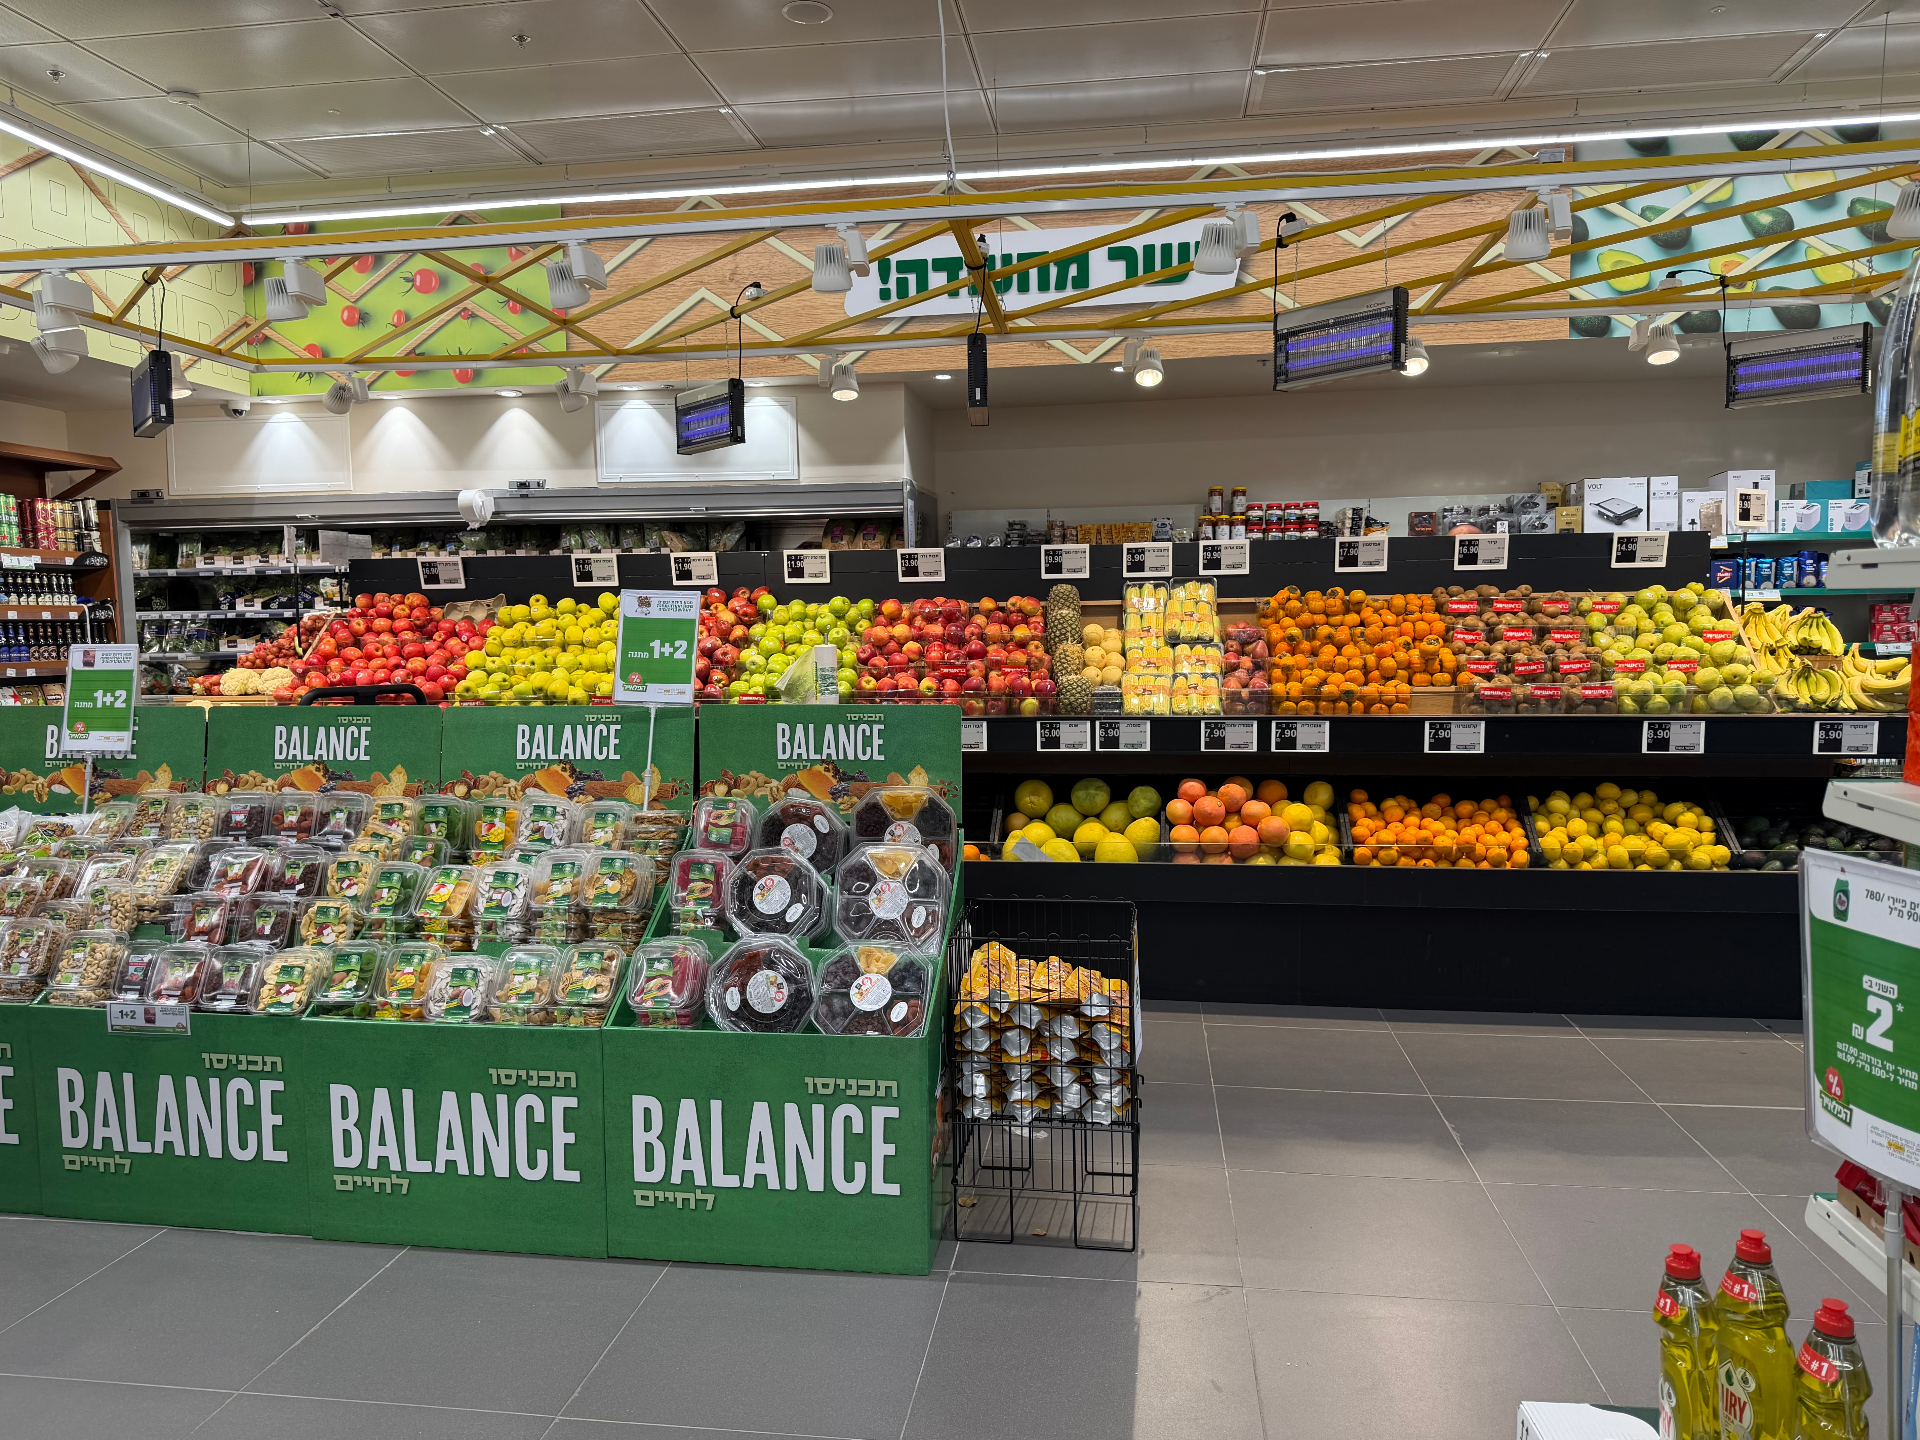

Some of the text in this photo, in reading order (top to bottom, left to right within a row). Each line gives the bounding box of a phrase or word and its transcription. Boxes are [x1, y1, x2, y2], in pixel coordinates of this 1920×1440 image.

[1108, 241, 1200, 284] שר
[649, 639, 688, 659] 1+2
[94, 690, 126, 708] 1+2
[337, 716, 371, 724] תכניסו
[585, 713, 621, 722] תכניסו
[846, 713, 884, 722] תכניסו
[1041, 729, 1060, 737] 15.00
[1205, 729, 1225, 737] 7.90
[1276, 729, 1296, 737] 7.90
[1648, 730, 1670, 738] 8.90
[1819, 731, 1842, 739] 8.90
[274, 725, 370, 760] BALANCE
[516, 724, 621, 760] BALANCE
[776, 723, 885, 760] BALANCE
[44, 760, 74, 768] לחיים
[274, 762, 304, 770] לחיים
[515, 761, 549, 770] לחיים
[776, 760, 811, 769] לחיים
[1887, 895, 1907, 909] פיירי
[1907, 911, 1920, 924] 90
[1875, 981, 1895, 996] השני
[119, 1010, 136, 1019] 1+2
[1866, 995, 1894, 1052] 2
[202, 1052, 283, 1072] תכניסו
[488, 1068, 577, 1088] תכניסו
[1897, 1066, 1918, 1081] מחיר
[804, 1076, 898, 1098] תכניסו
[1897, 1076, 1918, 1090] מחיר
[57, 1067, 288, 1162] BALANCE
[330, 1083, 581, 1183] BALANCE
[632, 1094, 900, 1196] BALANCE
[62, 1154, 132, 1174] לחיים
[333, 1174, 410, 1195] לחיים
[634, 1189, 715, 1211] לחיים
[1733, 1283, 1749, 1298] #1
[1659, 1297, 1671, 1312] #1
[1811, 1360, 1829, 1377] #1
[1720, 1384, 1747, 1424] IRY
